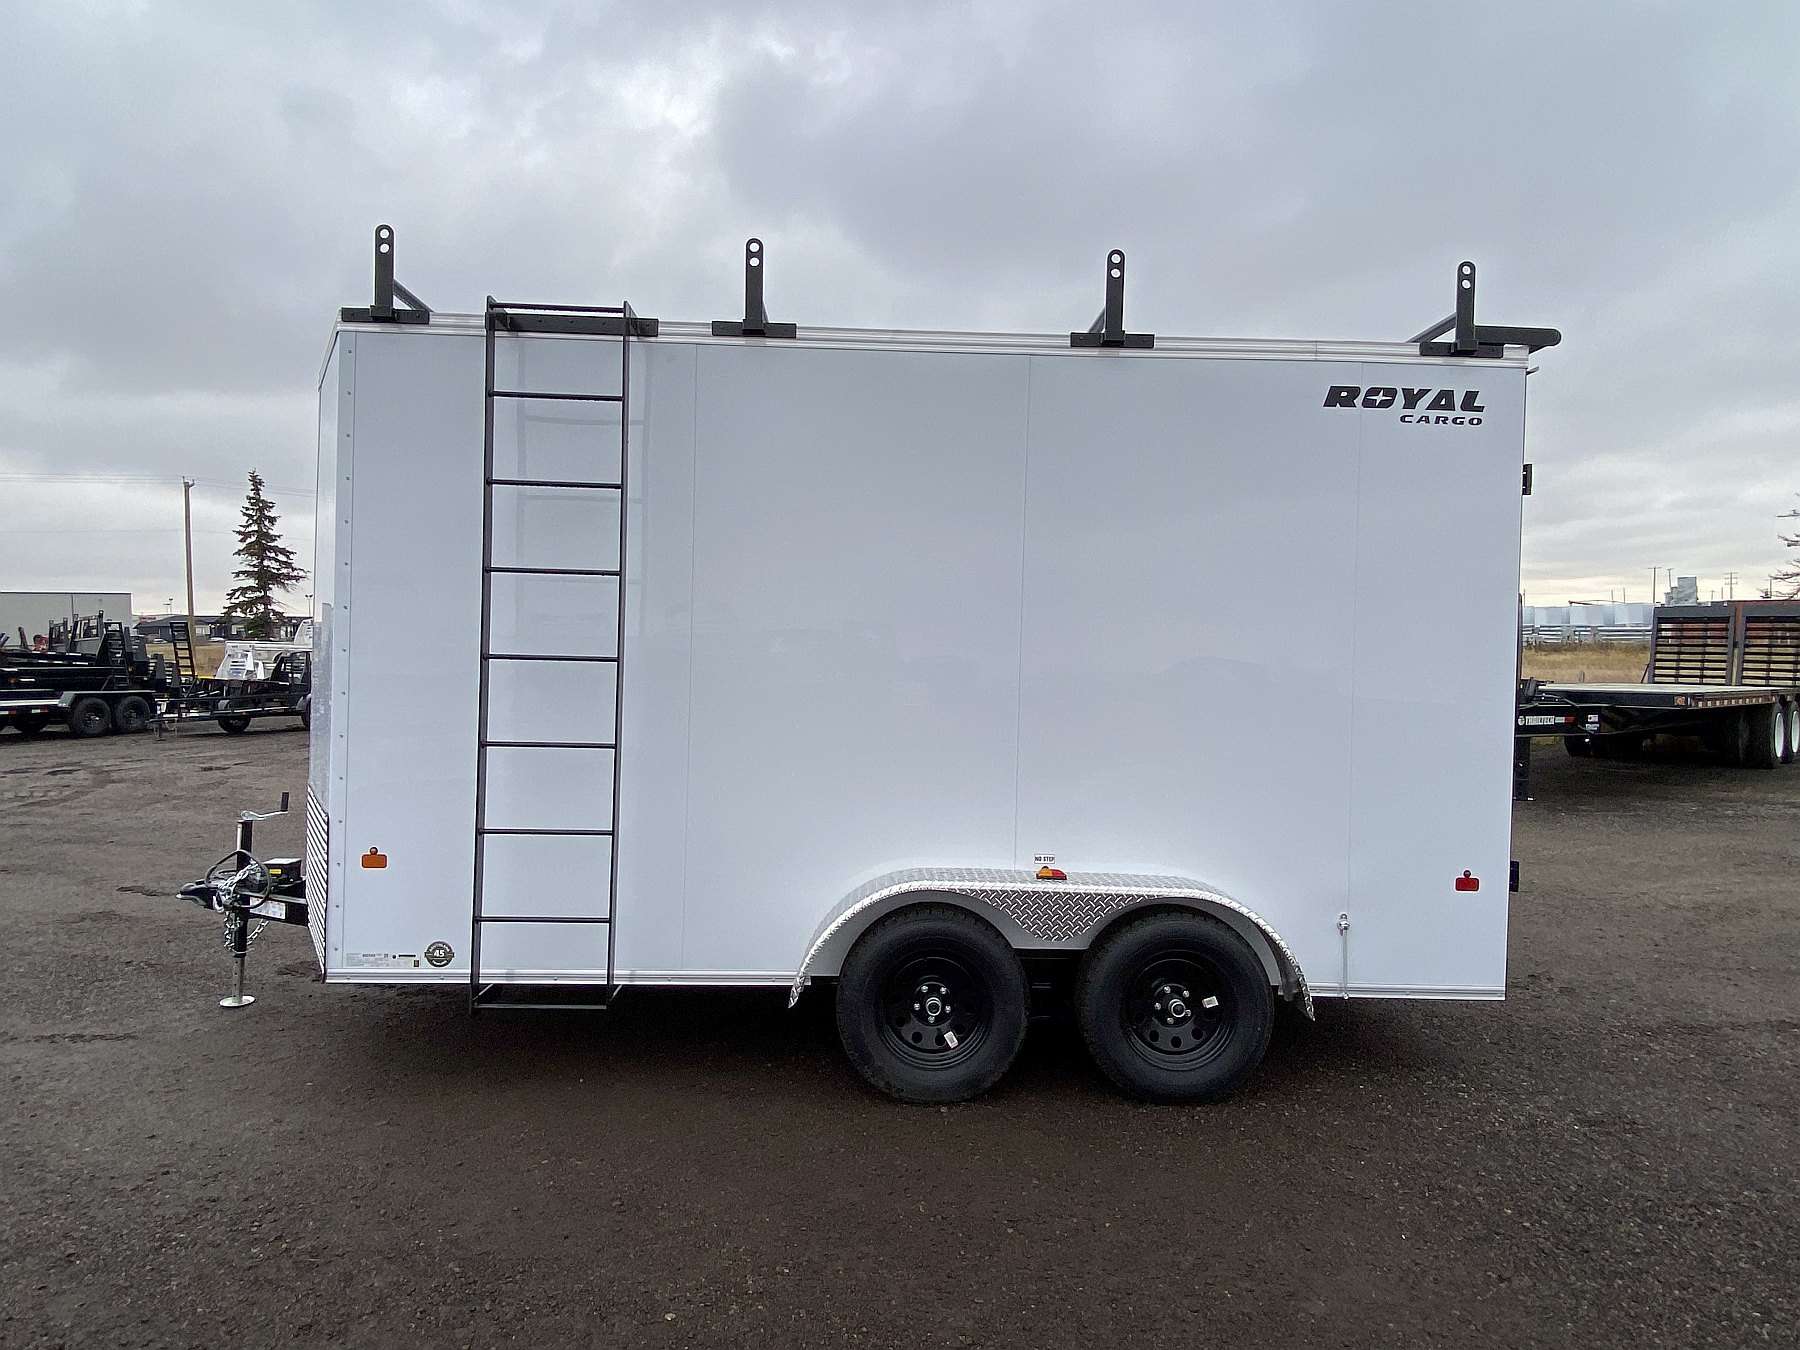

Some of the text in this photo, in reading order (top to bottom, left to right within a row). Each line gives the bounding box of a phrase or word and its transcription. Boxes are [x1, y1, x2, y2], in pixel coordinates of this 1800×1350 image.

[1323, 385, 1486, 412] ROYAL
[1400, 414, 1483, 426] CARGO
[433, 949, 445, 958] 45
